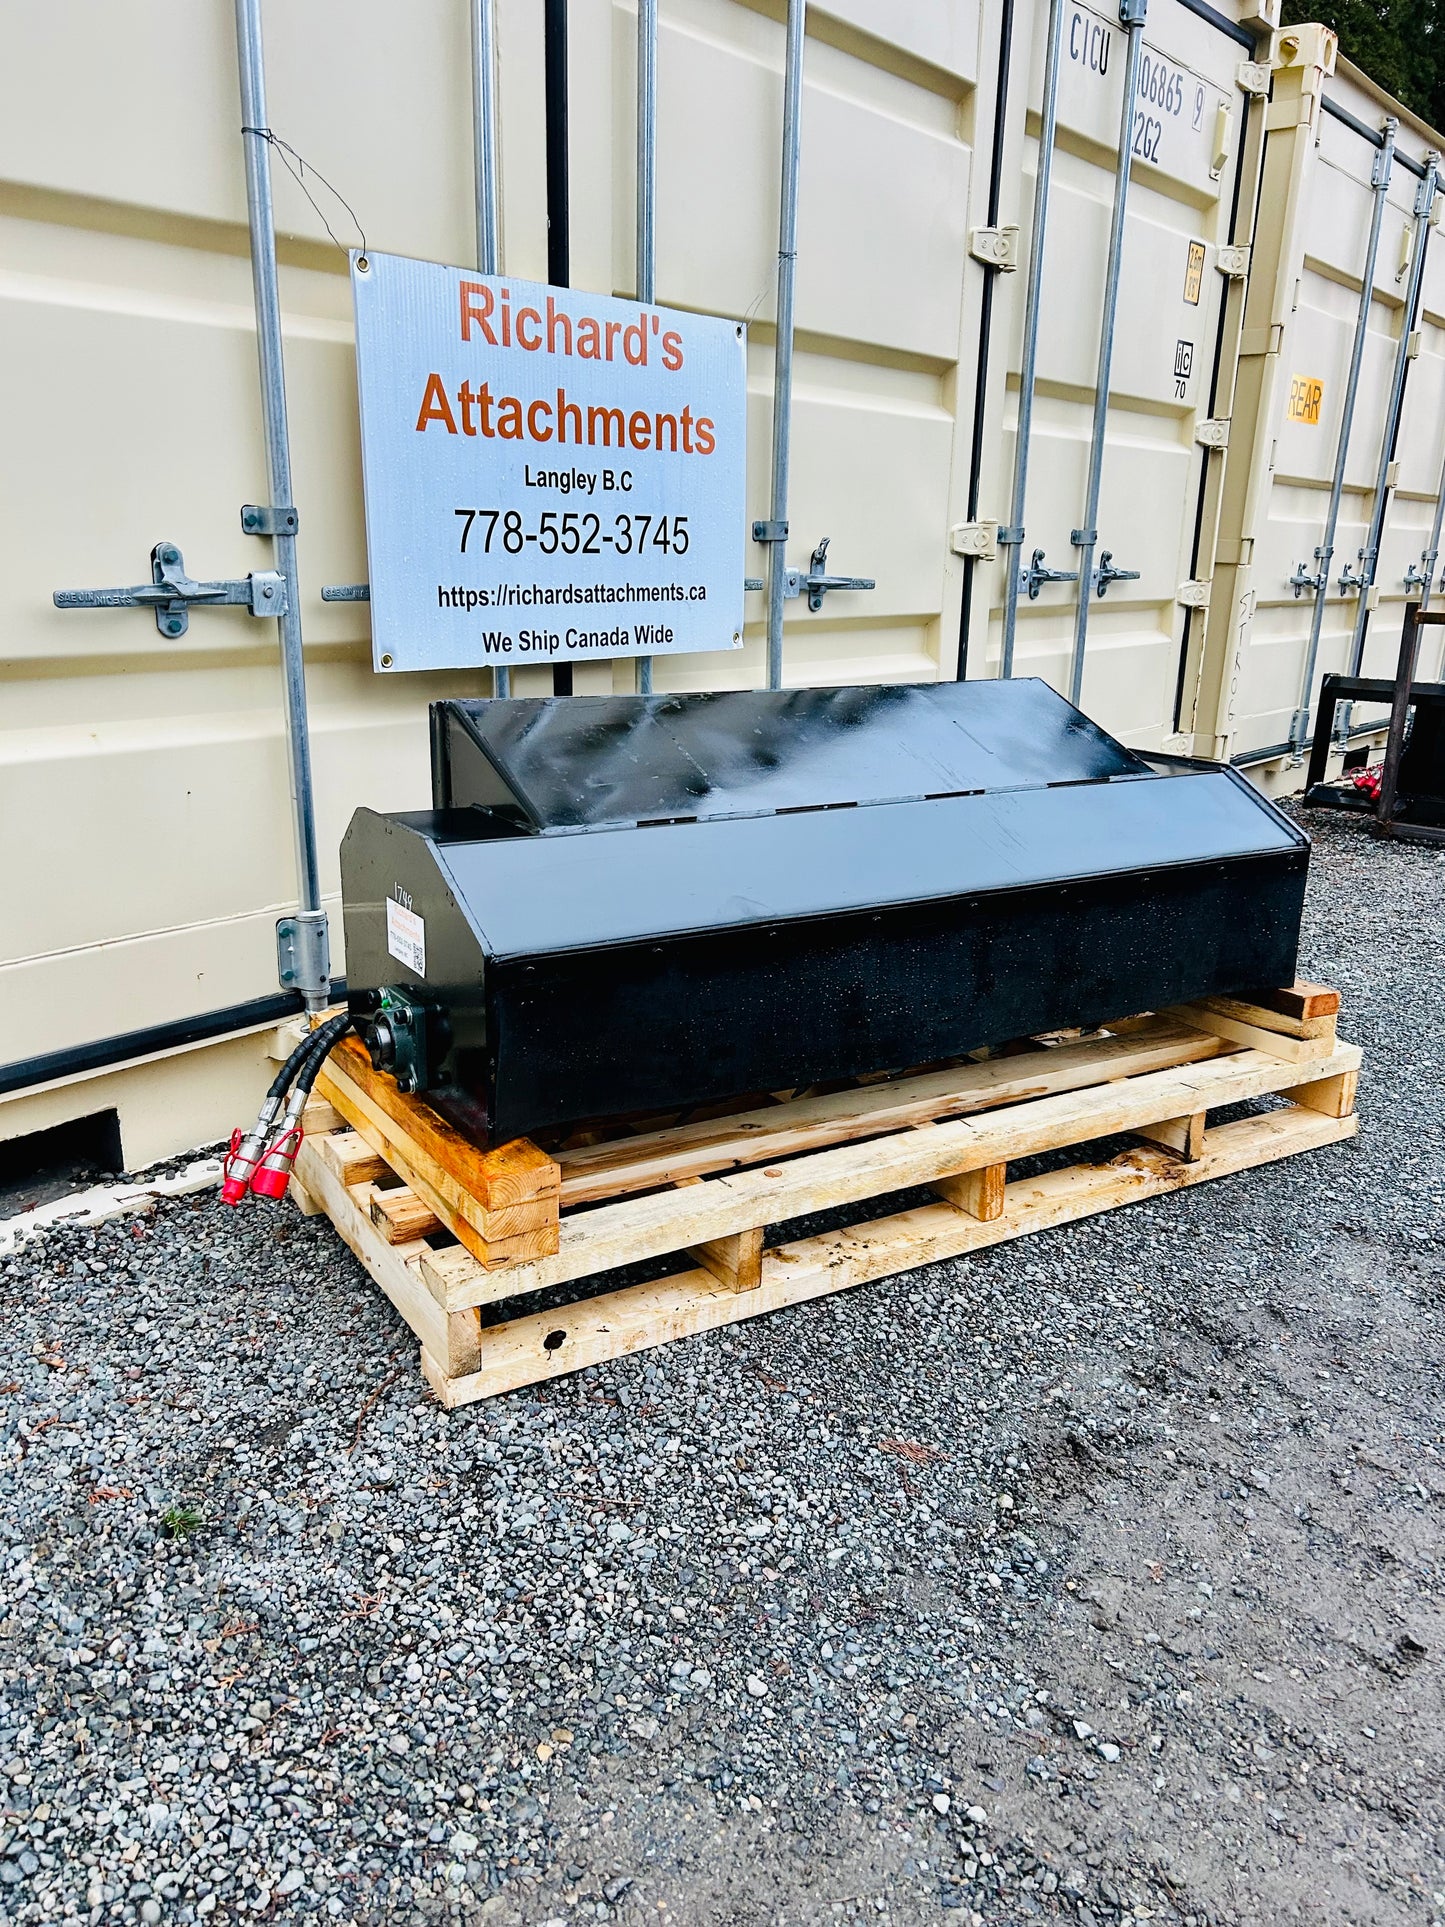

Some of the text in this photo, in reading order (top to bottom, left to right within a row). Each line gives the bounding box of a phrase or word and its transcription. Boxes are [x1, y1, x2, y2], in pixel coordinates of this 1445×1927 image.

[1070, 13, 1204, 126] CICU 06865 9
[459, 280, 684, 371] Richard's
[1174, 379, 1186, 399] 70
[1288, 379, 1322, 420] REAR
[415, 373, 716, 455] Attachments
[524, 465, 633, 495] Langley B.C
[454, 509, 689, 555] 778-552-3745
[57, 592, 77, 602] SAE
[438, 582, 706, 612] https://richardsattachments.ca
[482, 623, 674, 655] We Ship Canada Wide
